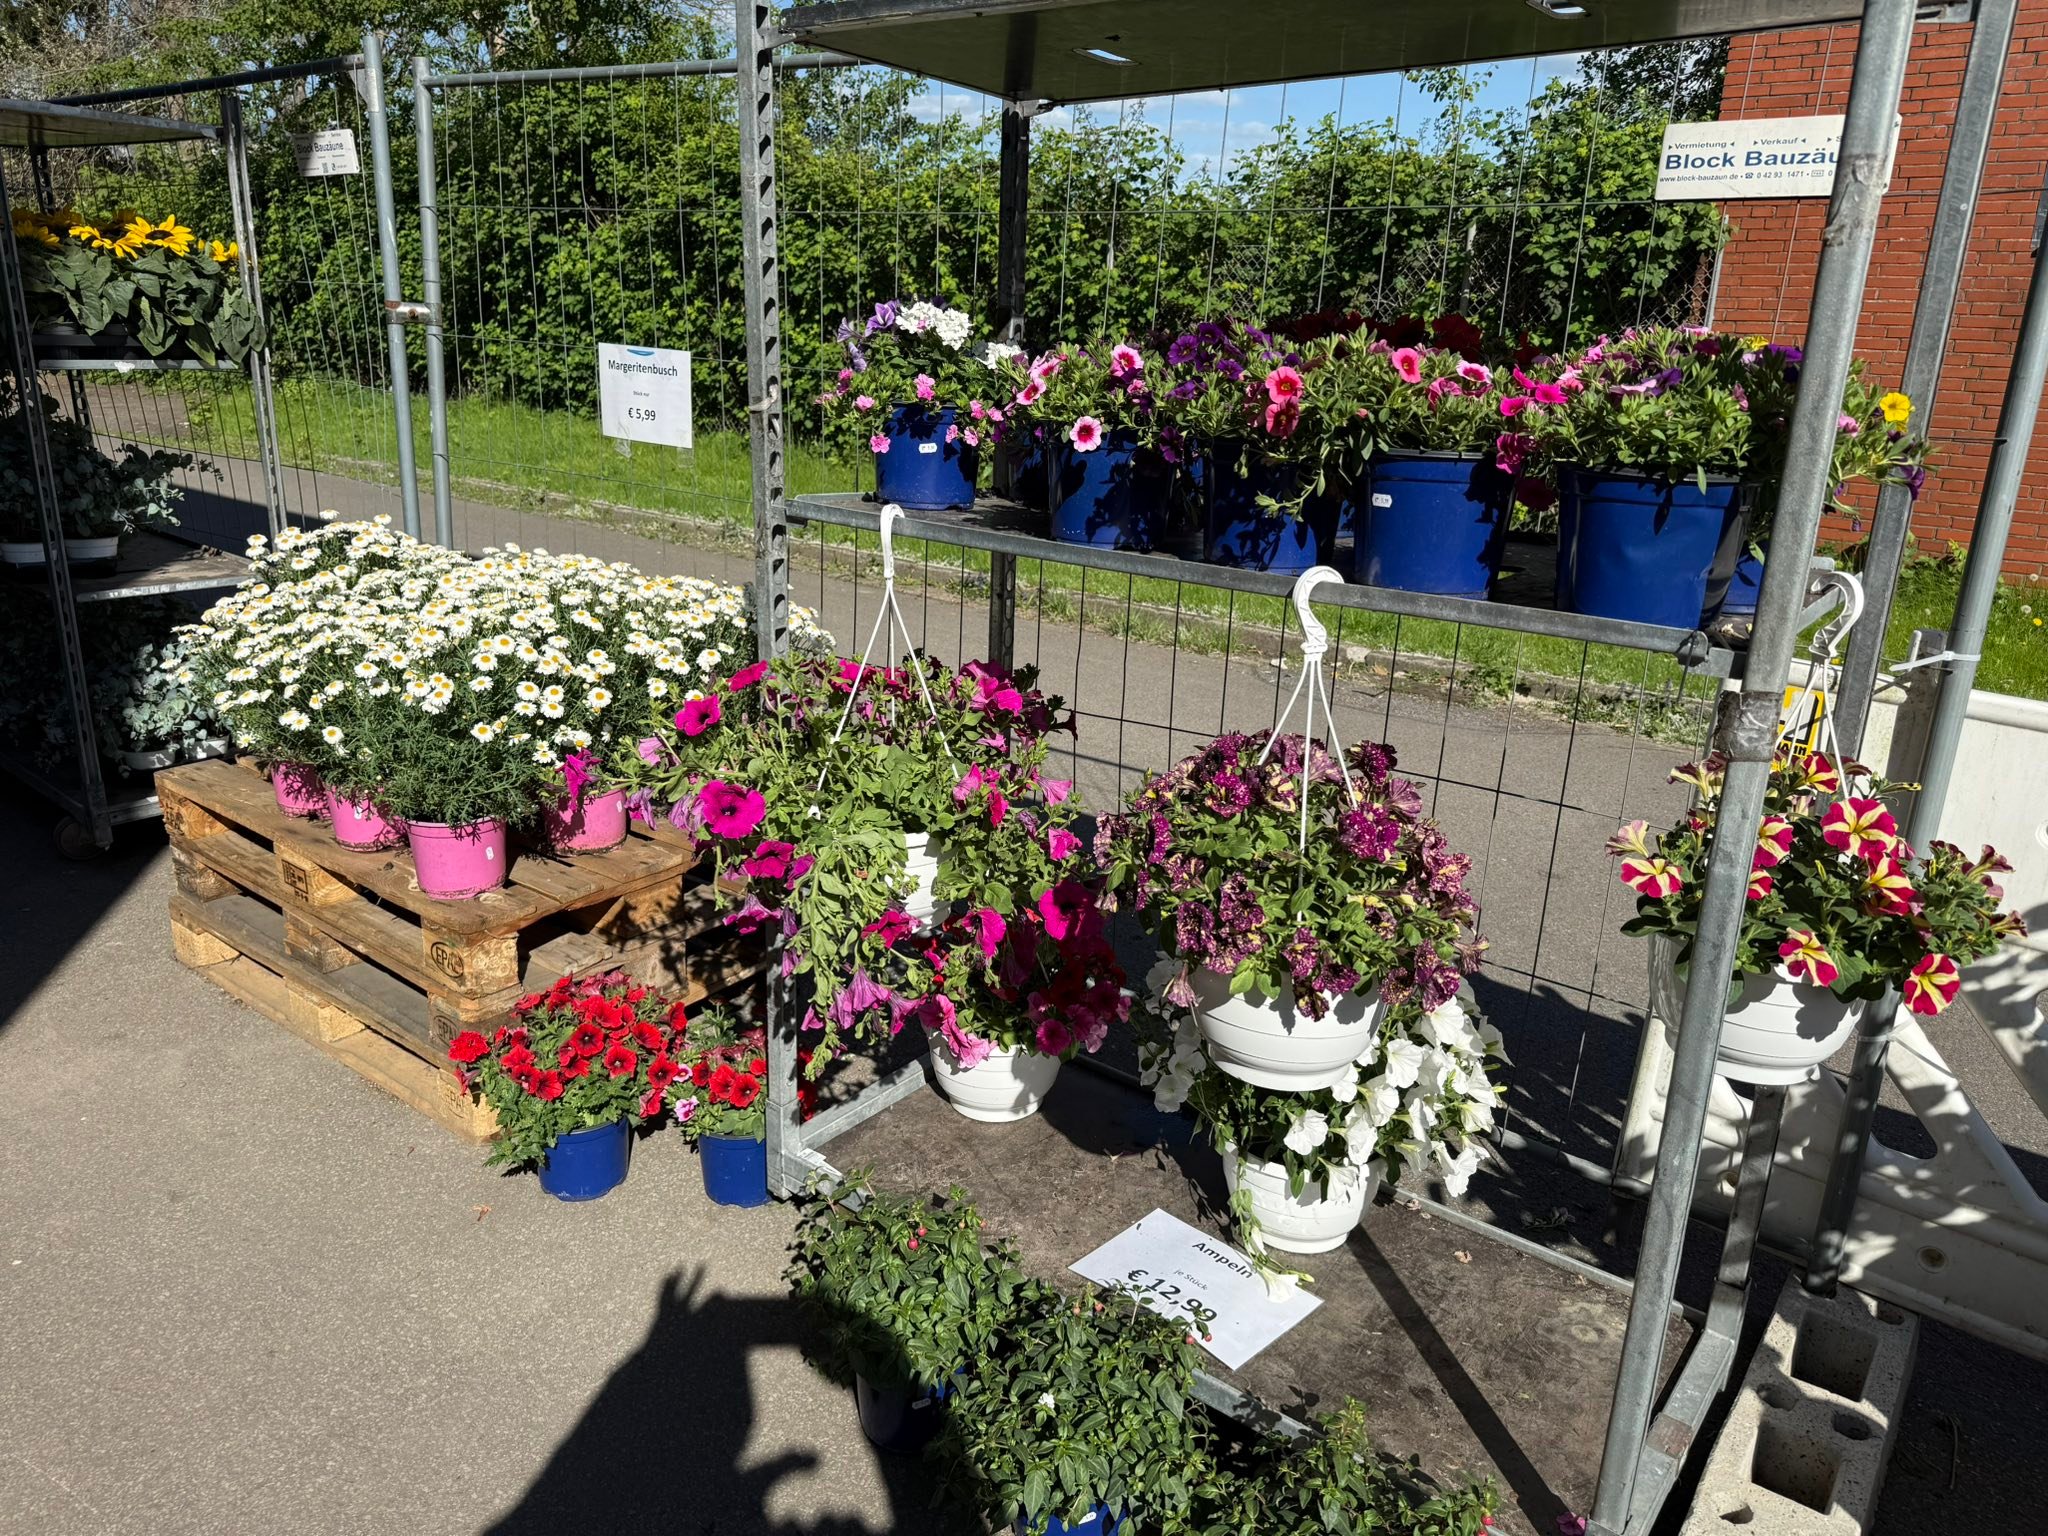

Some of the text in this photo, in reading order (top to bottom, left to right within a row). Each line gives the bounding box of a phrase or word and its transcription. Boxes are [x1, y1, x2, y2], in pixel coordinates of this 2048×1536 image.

[1675, 137, 1798, 150] Vermietung Verkauf
[1665, 152, 1735, 170] Block
[608, 359, 678, 377] Margeritenbusch
[628, 407, 656, 422] € 5,99
[1192, 1242, 1254, 1279] Ampeln
[1174, 1268, 1208, 1291] je Stück
[1127, 1269, 1218, 1322] € 12,99
